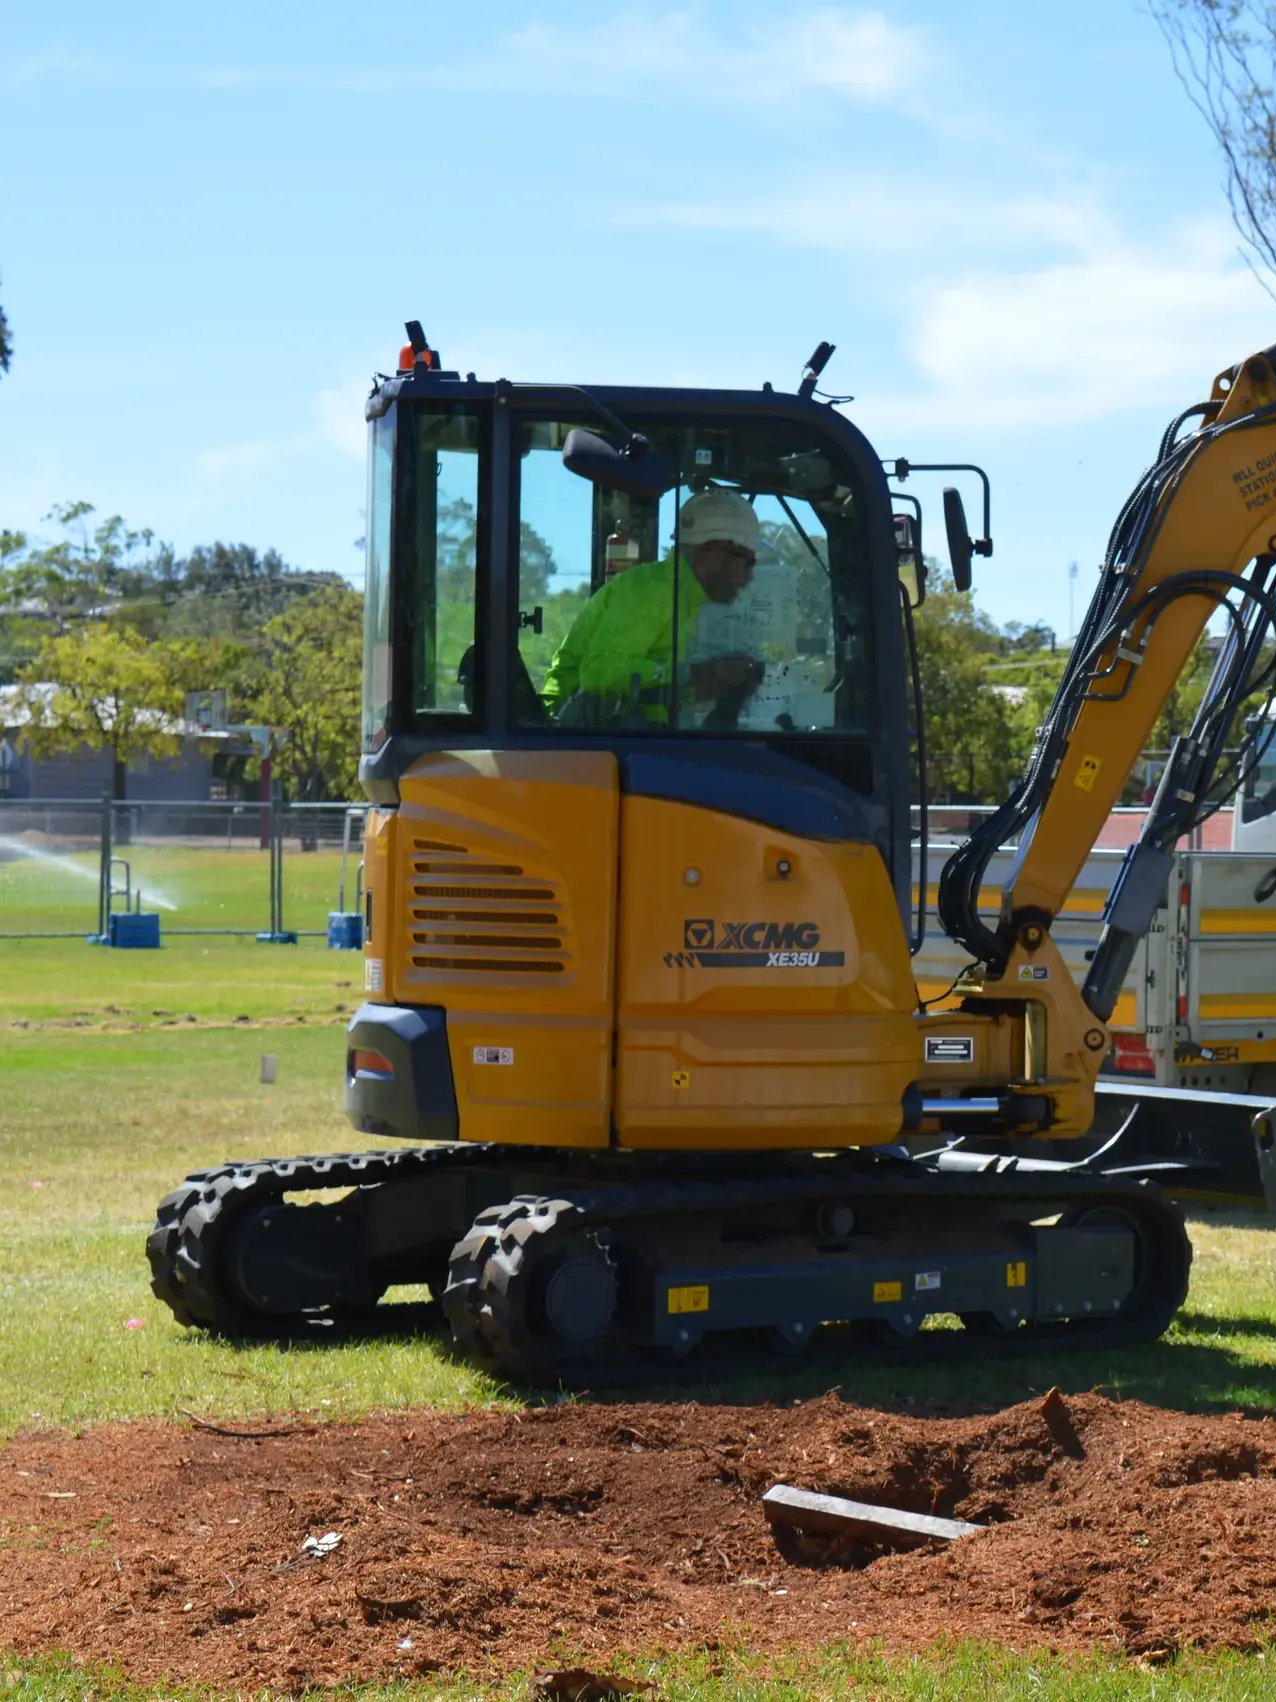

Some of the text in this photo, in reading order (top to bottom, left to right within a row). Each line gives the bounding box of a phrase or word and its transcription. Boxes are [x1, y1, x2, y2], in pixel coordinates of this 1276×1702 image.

[1231, 466, 1256, 484] WLL
[1245, 490, 1272, 512] PICK
[715, 922, 821, 950] XCMG
[766, 952, 821, 968] XE35U
